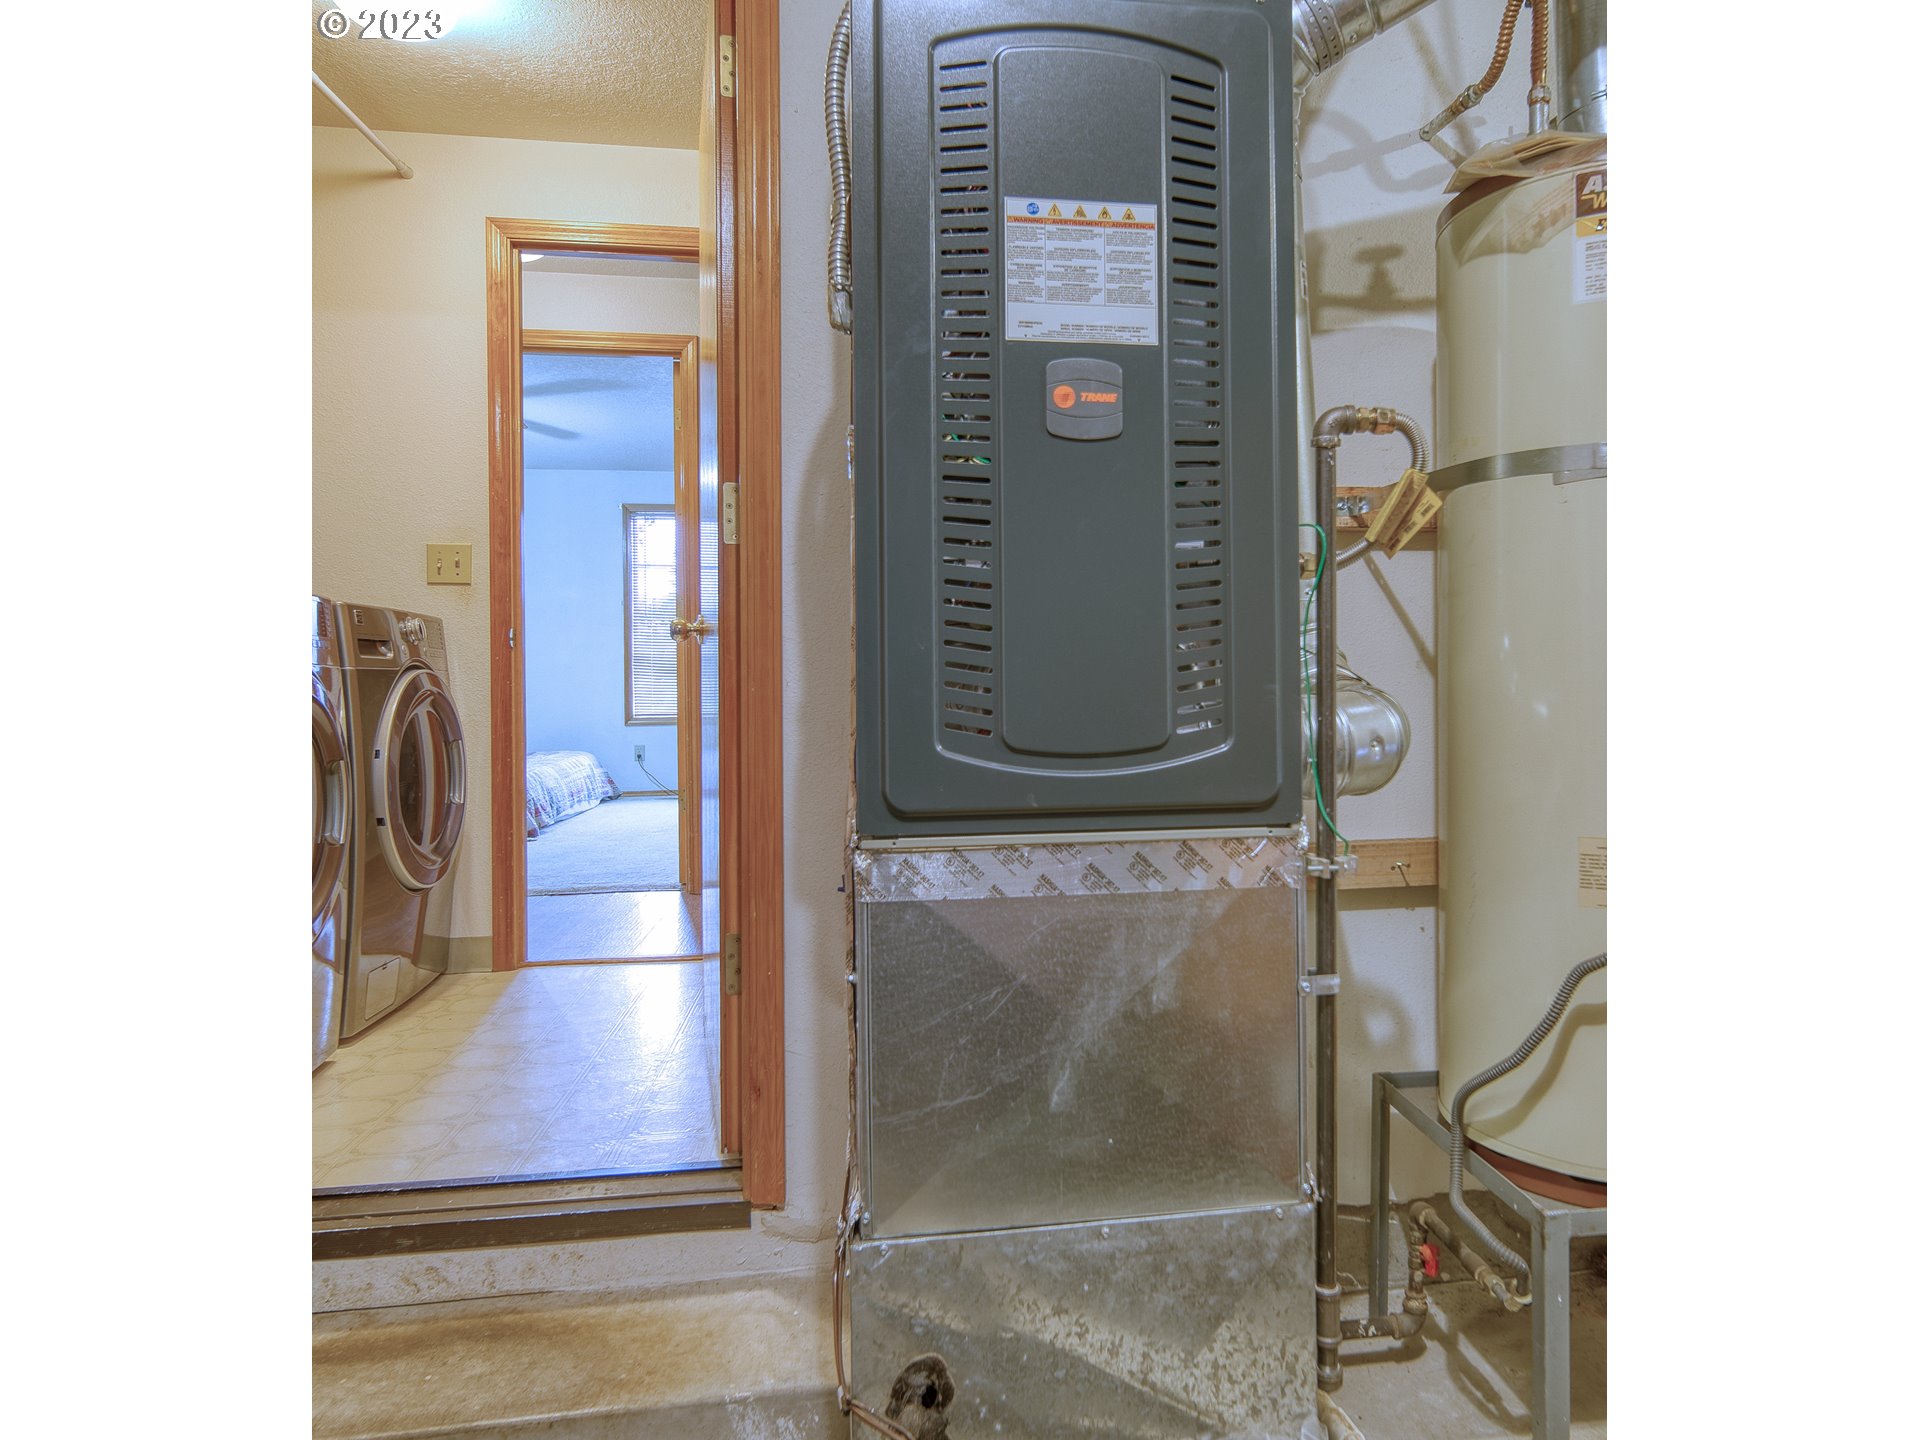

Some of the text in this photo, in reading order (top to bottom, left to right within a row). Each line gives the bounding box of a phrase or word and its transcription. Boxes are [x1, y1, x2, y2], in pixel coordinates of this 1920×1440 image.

[1052, 219, 1103, 227] AVERTISSEMENT
[1111, 222, 1155, 230] ADVERTENCIA
[1080, 391, 1118, 403] TRANE
